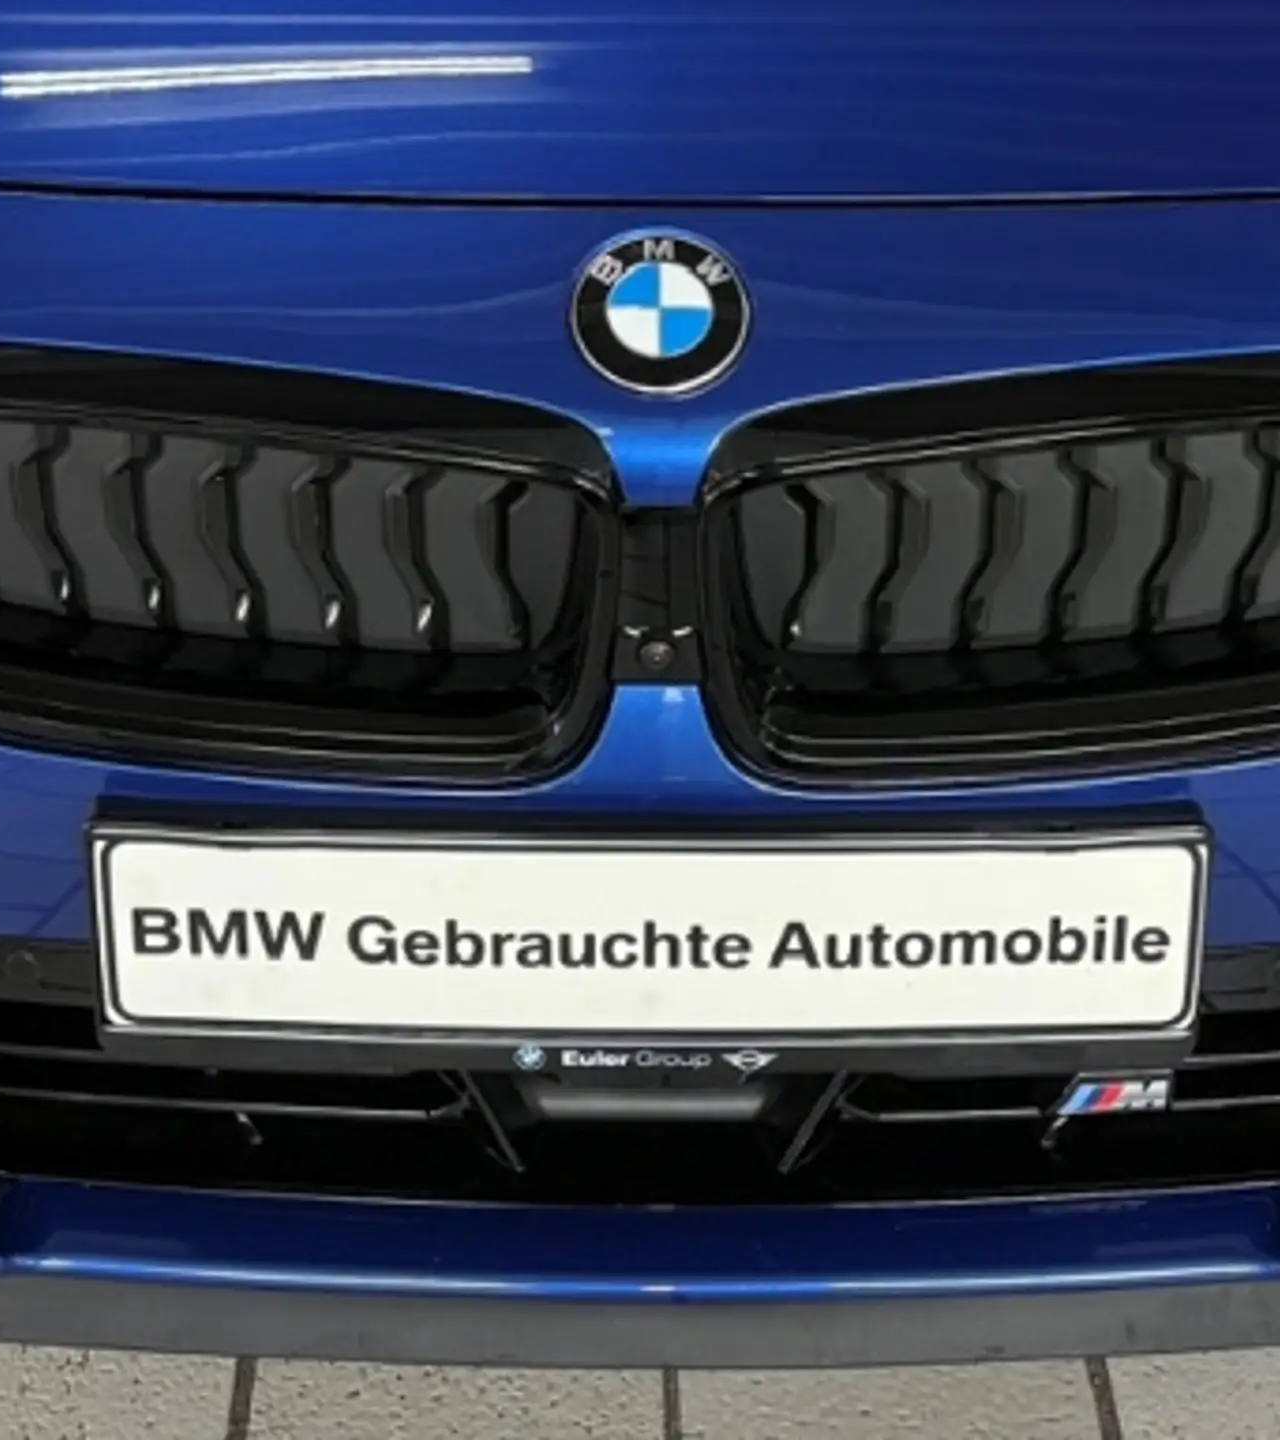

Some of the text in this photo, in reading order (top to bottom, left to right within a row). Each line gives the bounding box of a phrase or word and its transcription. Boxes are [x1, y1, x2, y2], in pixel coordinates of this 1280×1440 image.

[590, 239, 732, 286] BMW
[133, 907, 1170, 969] BMW Gebrauchte Automobile
[561, 1049, 713, 1070] Euler Group
